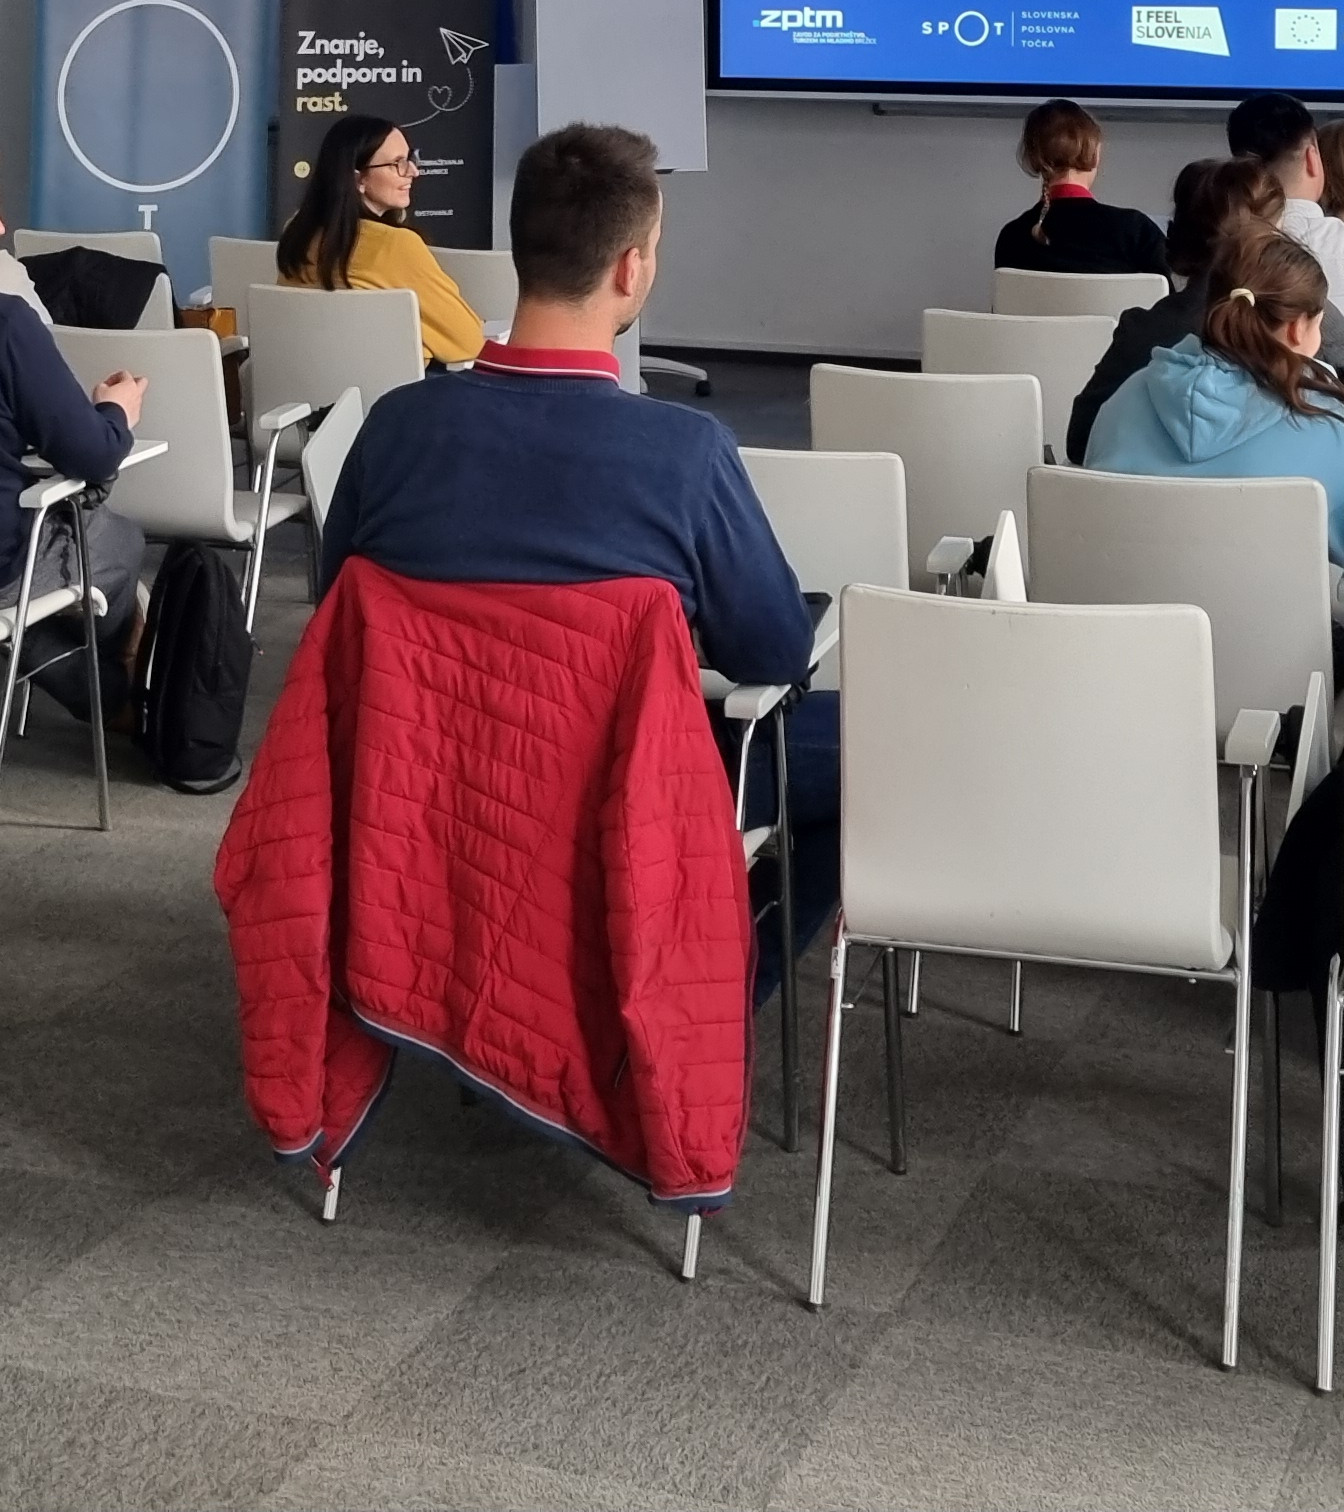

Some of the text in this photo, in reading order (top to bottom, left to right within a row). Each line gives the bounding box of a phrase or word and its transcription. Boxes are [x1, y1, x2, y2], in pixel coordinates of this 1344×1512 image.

[1021, 11, 1080, 20] SLOVENSKA
[1146, 10, 1182, 24] FEEL
[1021, 25, 1075, 34] POSLOVNA
[1136, 25, 1212, 40] SLOVENIA
[296, 30, 385, 62] Znanje,
[1021, 38, 1055, 48] TOČKA
[296, 59, 422, 90] podpora in
[296, 91, 349, 113] rast.
